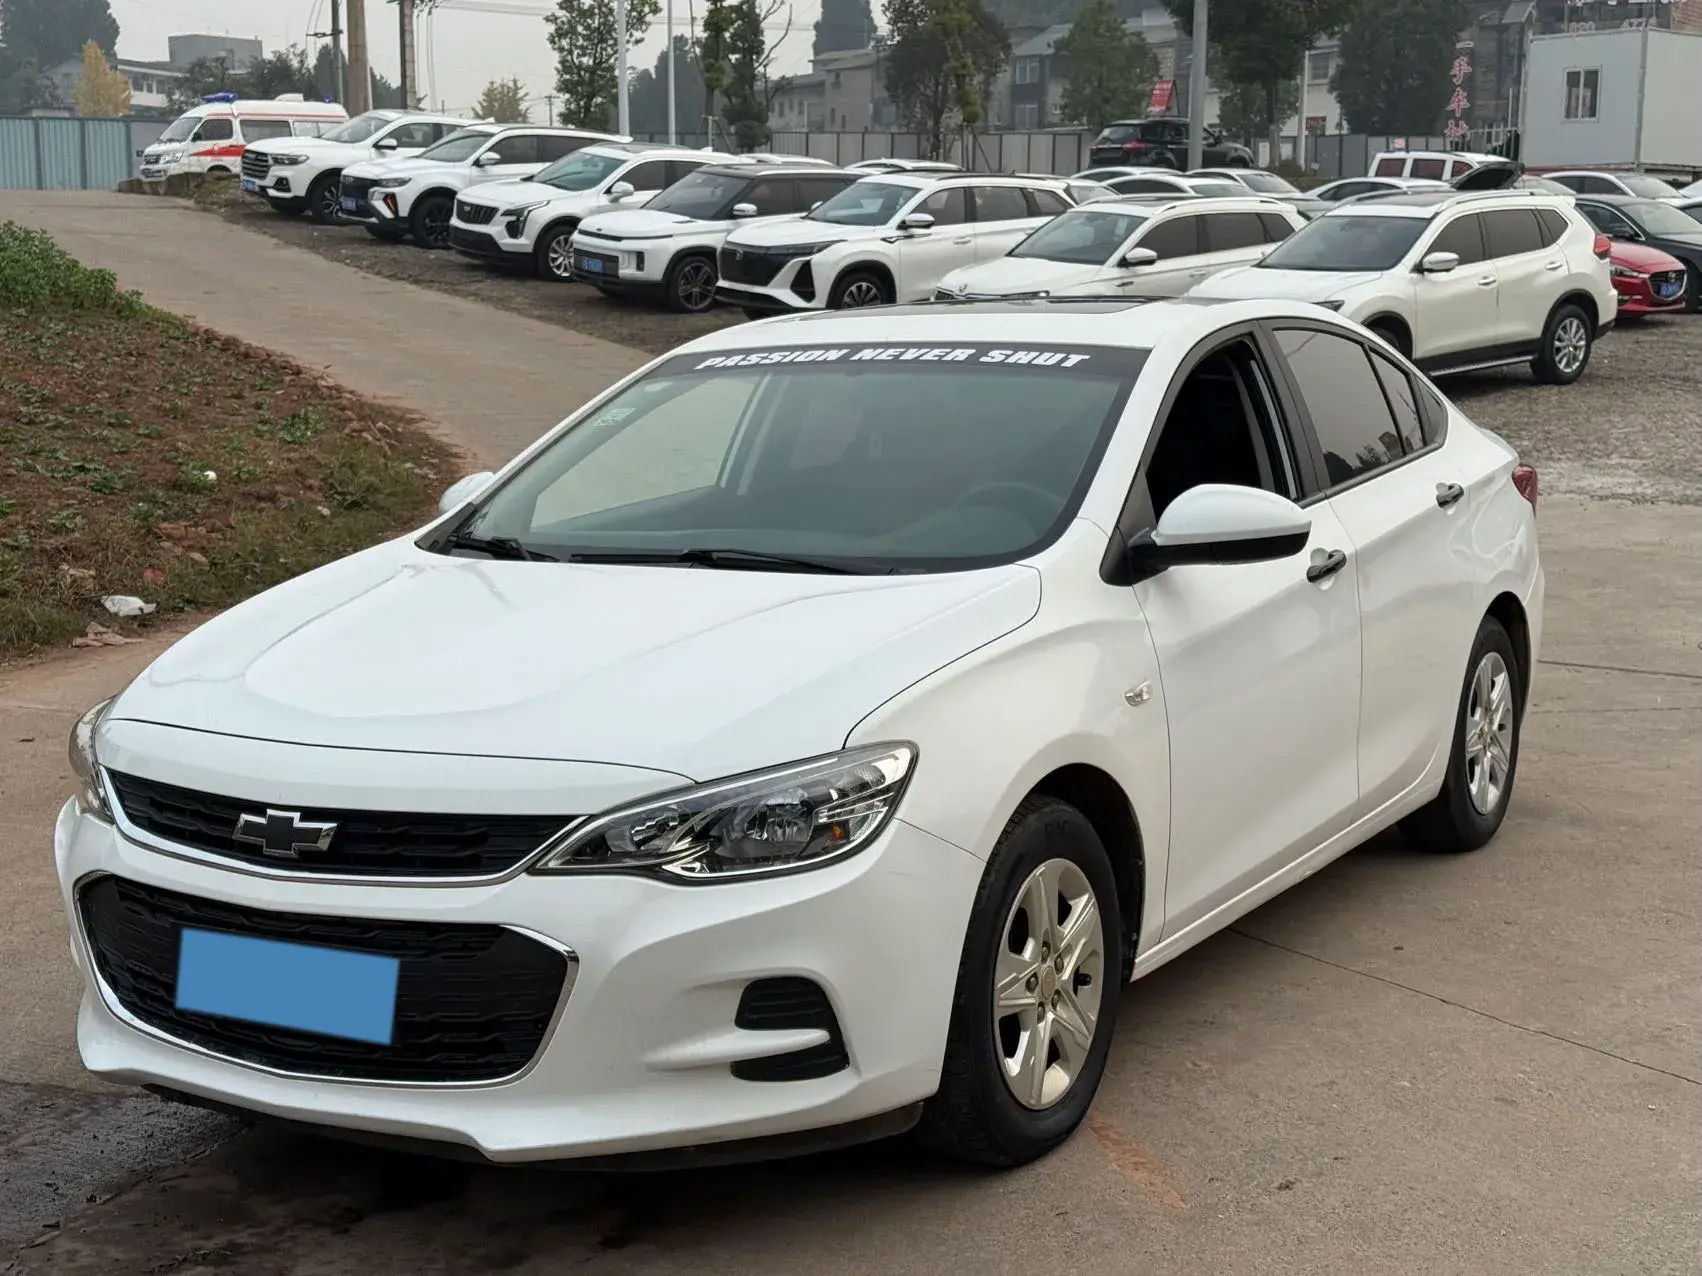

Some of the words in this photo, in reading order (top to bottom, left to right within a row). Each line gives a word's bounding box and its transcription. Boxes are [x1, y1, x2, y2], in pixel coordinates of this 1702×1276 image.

[694, 349, 850, 370] PASSION
[849, 348, 977, 363] NEVER
[979, 350, 1092, 369] SHUT
